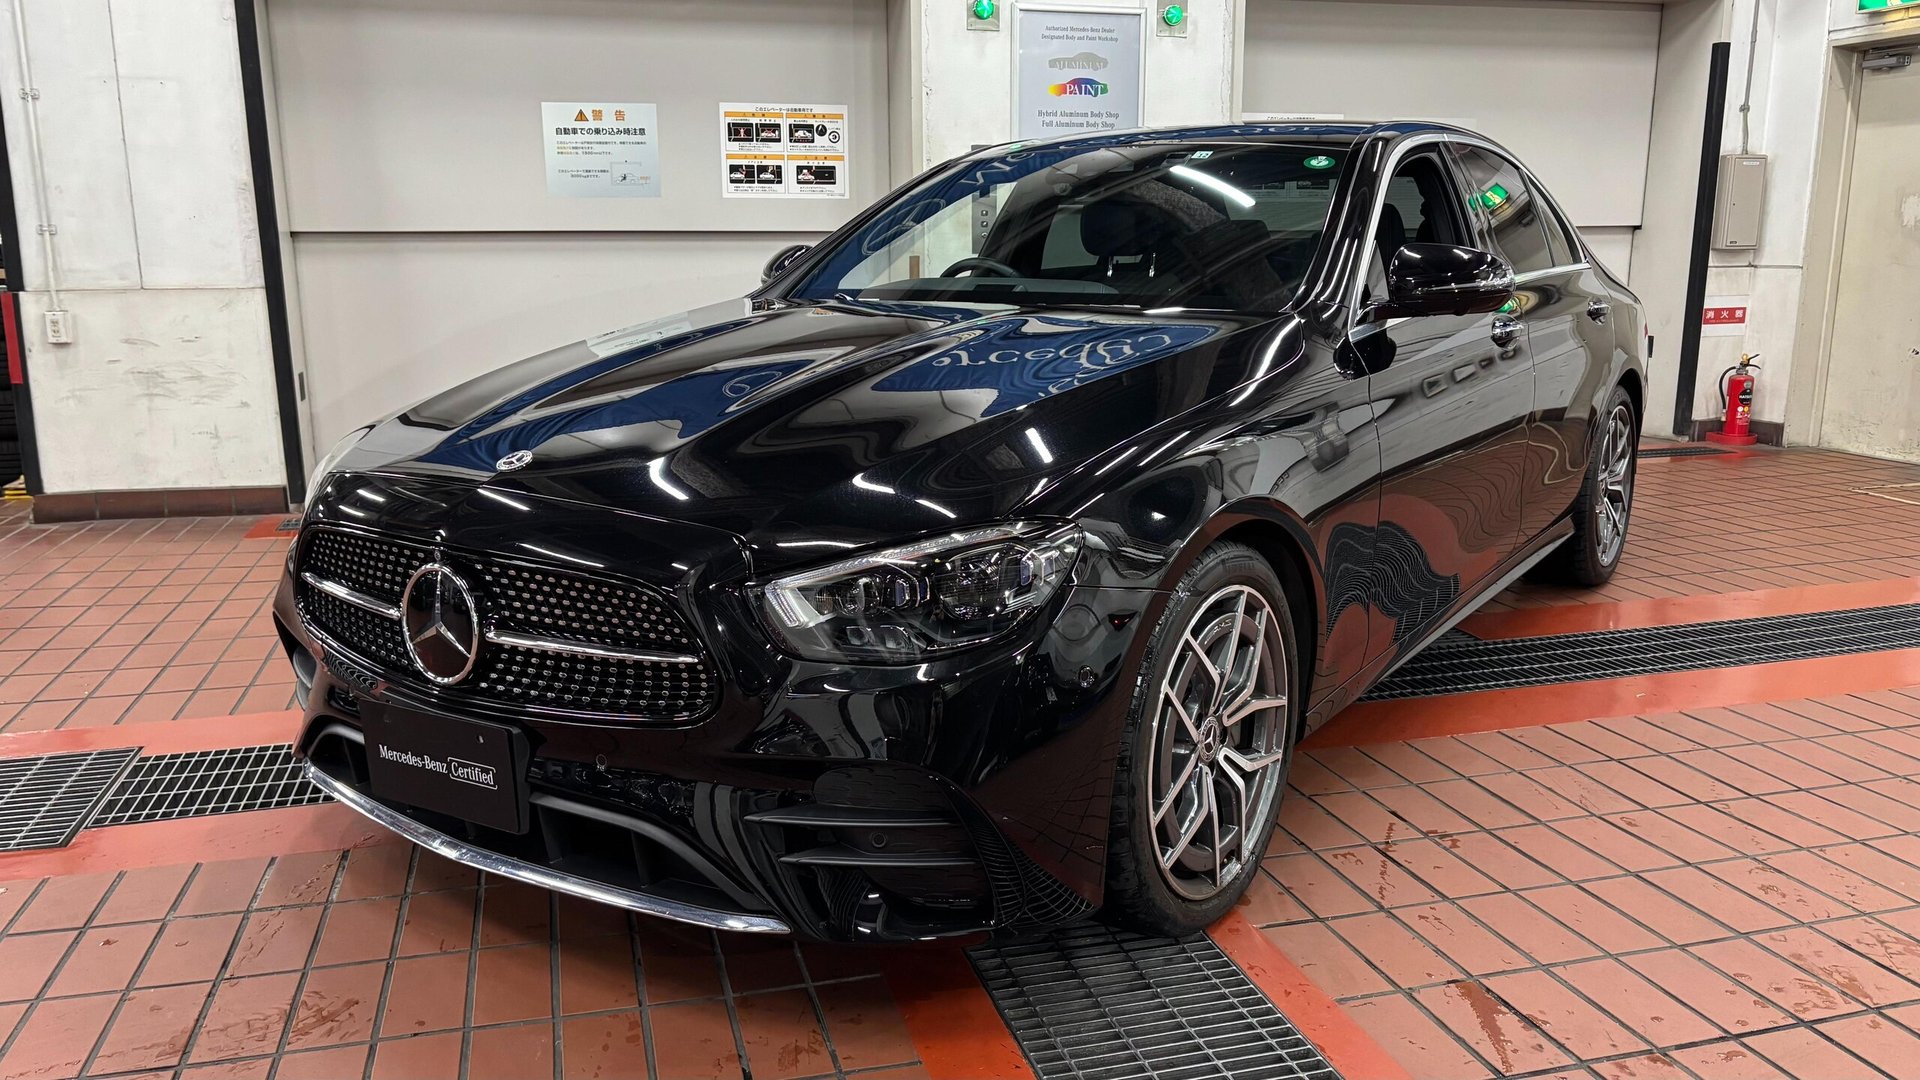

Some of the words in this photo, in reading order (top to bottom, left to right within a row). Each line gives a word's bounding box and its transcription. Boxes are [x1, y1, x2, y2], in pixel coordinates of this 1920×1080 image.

[1055, 60, 1104, 70] ALUMINUM
[1066, 84, 1104, 97] PAINT
[1037, 109, 1058, 119] Hybrid
[1058, 110, 1089, 118] Aluminum
[1090, 110, 1104, 119] Body
[1105, 111, 1119, 120] Shop
[1085, 121, 1100, 130] Body
[1100, 121, 1115, 130] Shop
[555, 127, 646, 136] 自動車での乗り込み時注意
[1705, 309, 1744, 320] 消火器
[378, 744, 448, 774] Mercedes-Benz
[451, 761, 494, 785] Certified
